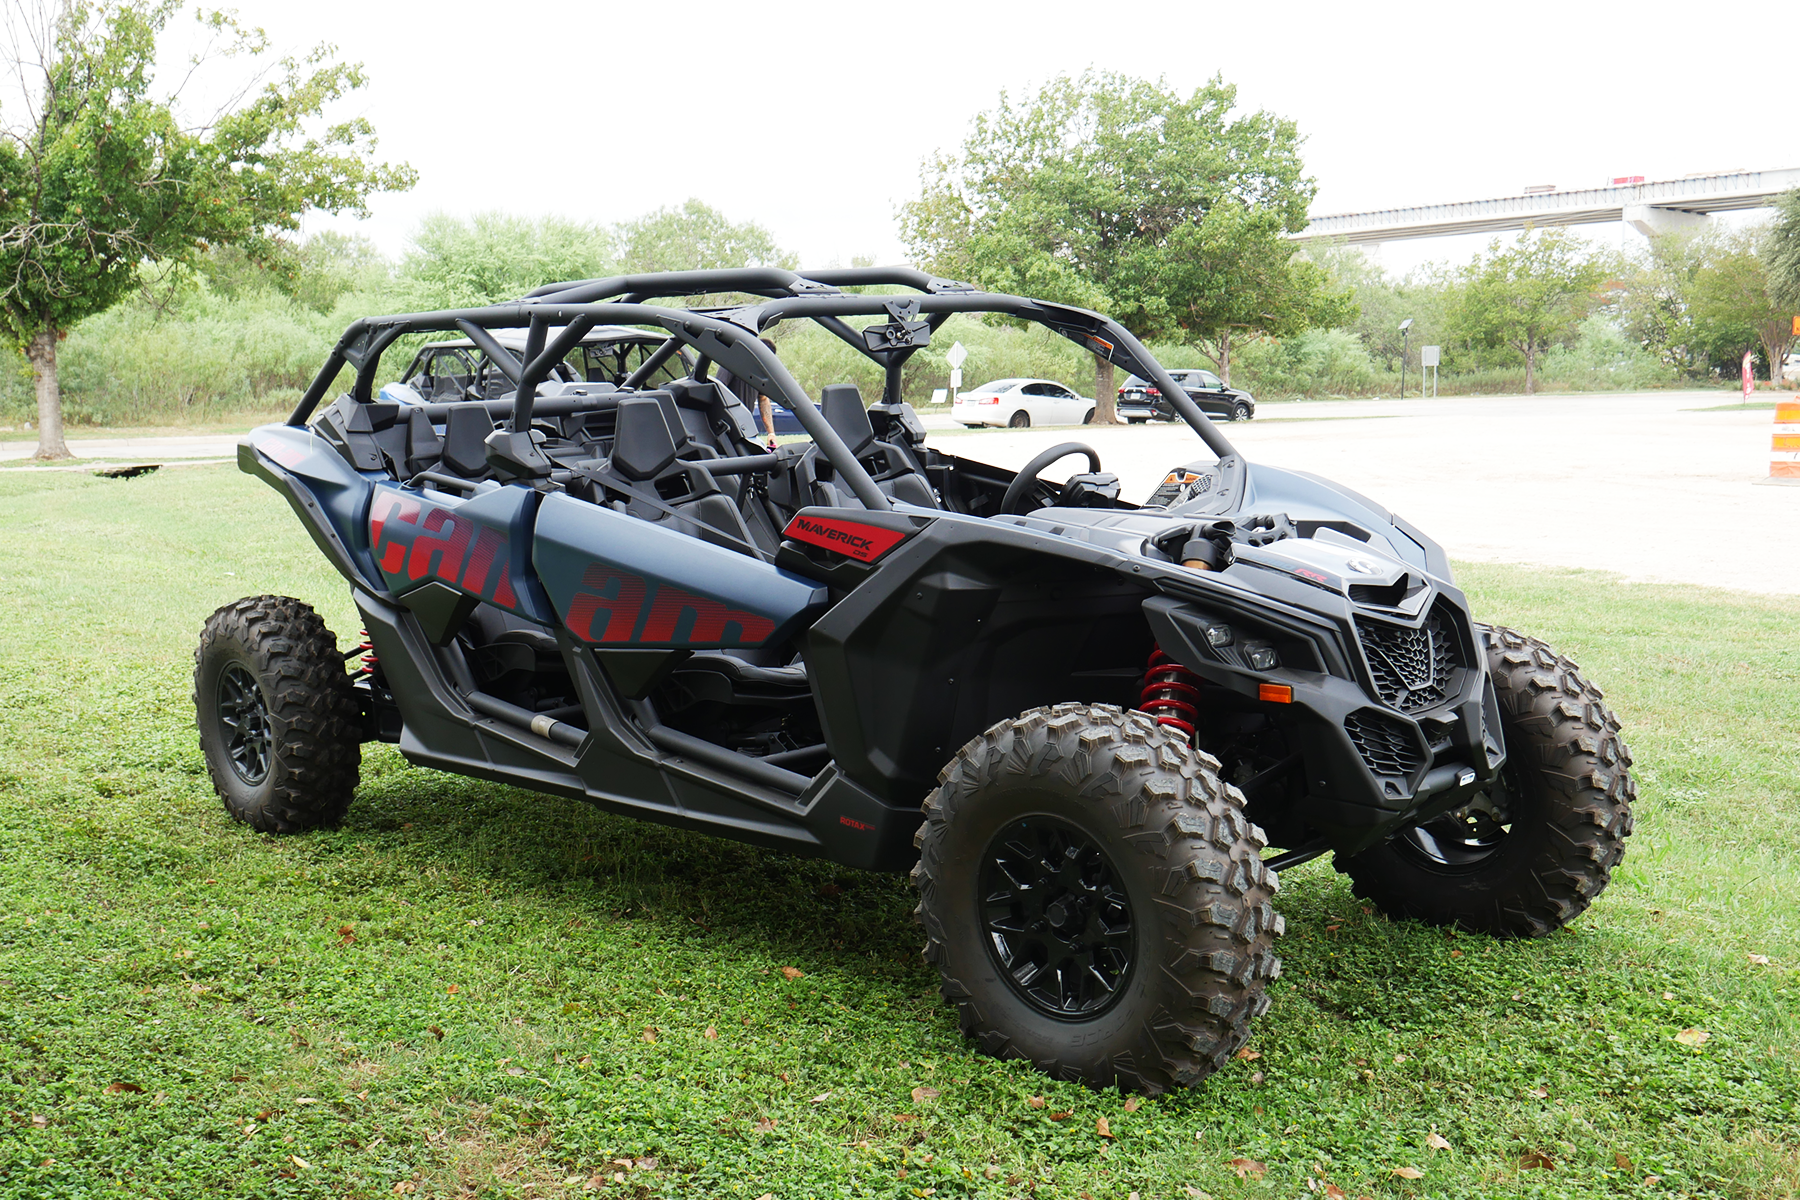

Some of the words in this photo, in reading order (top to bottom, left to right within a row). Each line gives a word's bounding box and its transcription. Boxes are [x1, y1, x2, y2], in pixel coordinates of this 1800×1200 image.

[796, 518, 874, 551] MAVERICK
[1294, 568, 1328, 583] RR
[839, 815, 866, 831] ROTAX
